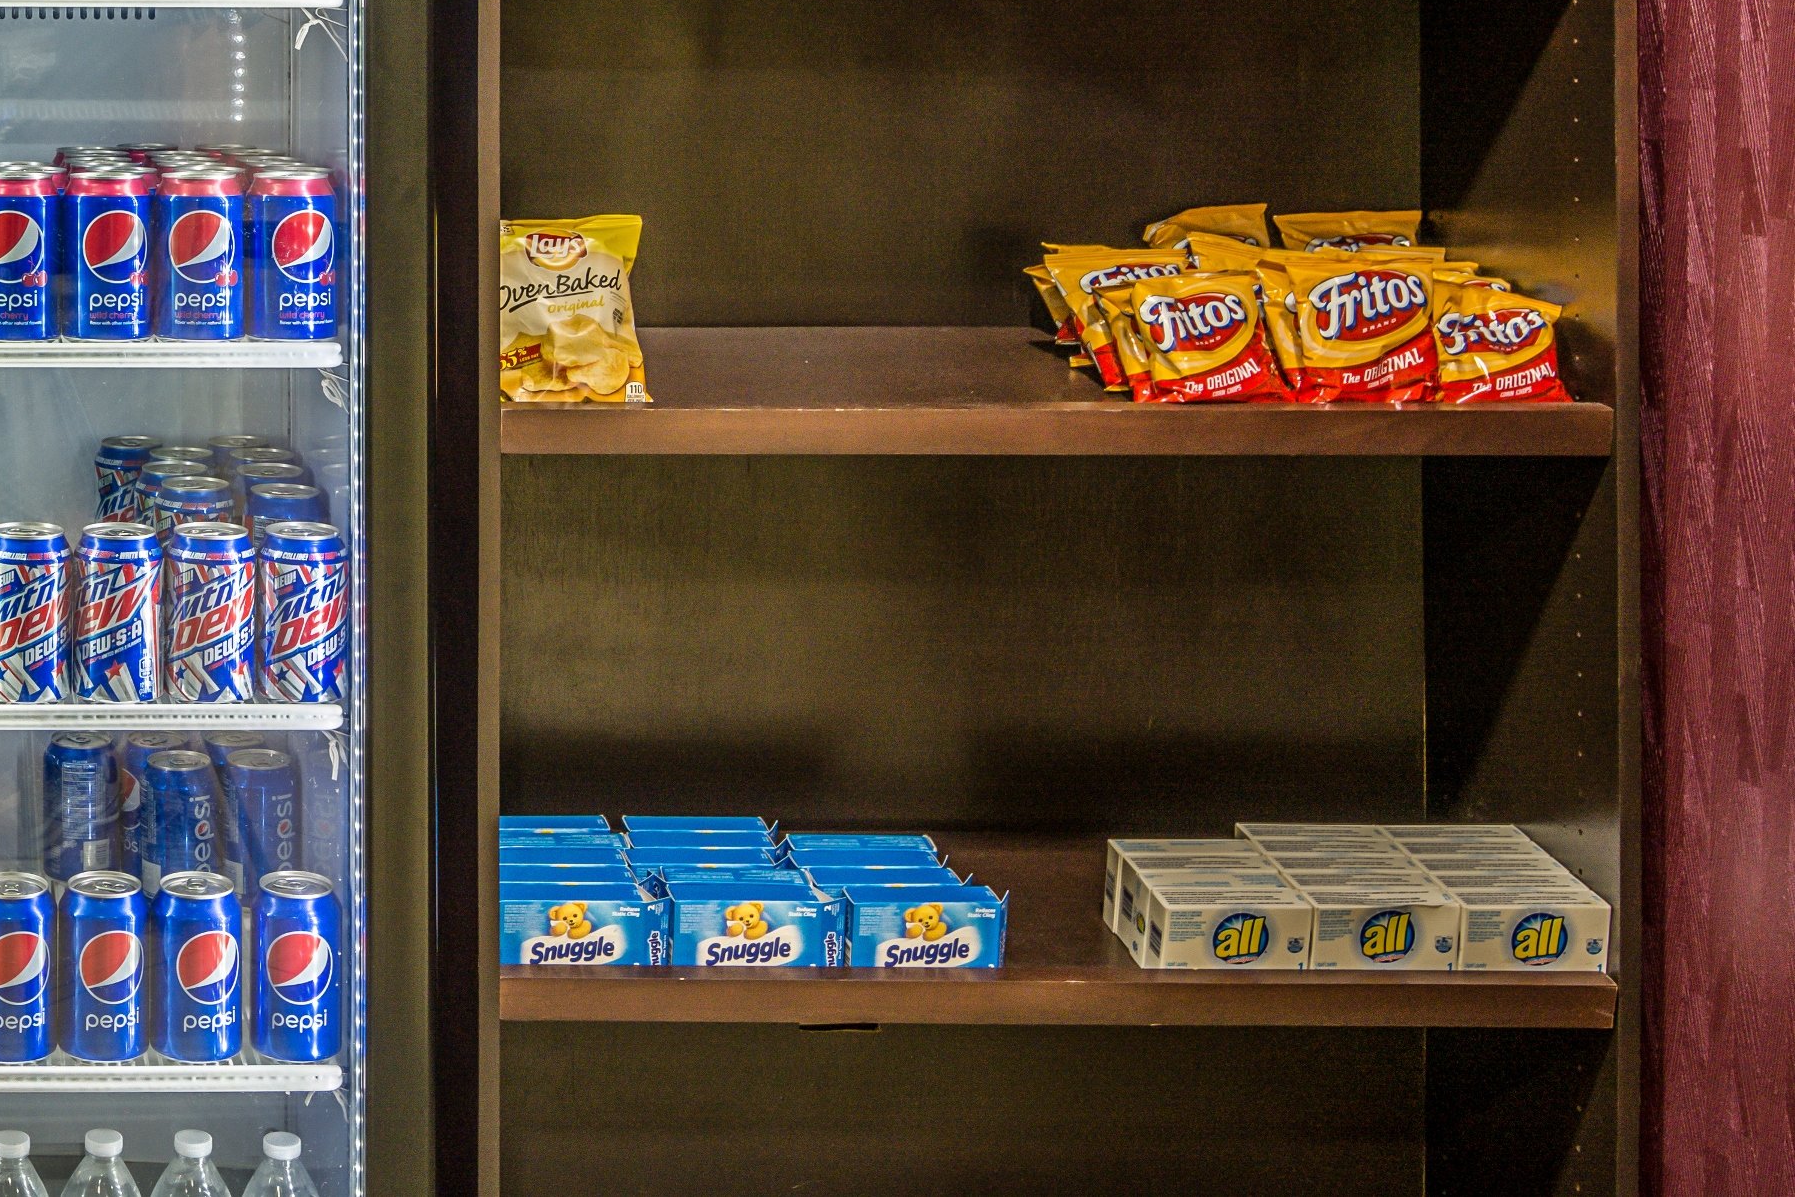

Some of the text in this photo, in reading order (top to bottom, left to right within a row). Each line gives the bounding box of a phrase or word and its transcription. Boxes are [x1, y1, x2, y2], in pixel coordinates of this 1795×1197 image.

[557, 267, 622, 294] Baked
[89, 289, 143, 311] pepsi
[175, 289, 230, 310] pepsi
[279, 288, 331, 310] pepsi
[548, 296, 604, 317] Original
[1308, 272, 1426, 339] Fritos
[1139, 294, 1247, 352] Fritos
[1362, 318, 1397, 333] BRAND
[1436, 310, 1547, 355] Fritos
[1185, 358, 1261, 393] The ORIGINAL
[1342, 348, 1424, 385] The ORIGINAL
[1472, 362, 1555, 392] The ORIGINAL
[630, 385, 642, 394] 110
[274, 572, 297, 589] NEW!
[1214, 916, 1266, 959] all
[1362, 912, 1411, 957] all
[1514, 916, 1564, 960] all
[530, 936, 615, 965] Snuggle
[706, 937, 791, 966] Snuggle
[884, 938, 970, 968] Snuggle
[86, 1006, 140, 1033] pepsi
[183, 1005, 236, 1033] pepsi
[272, 1005, 328, 1033] pepsi
